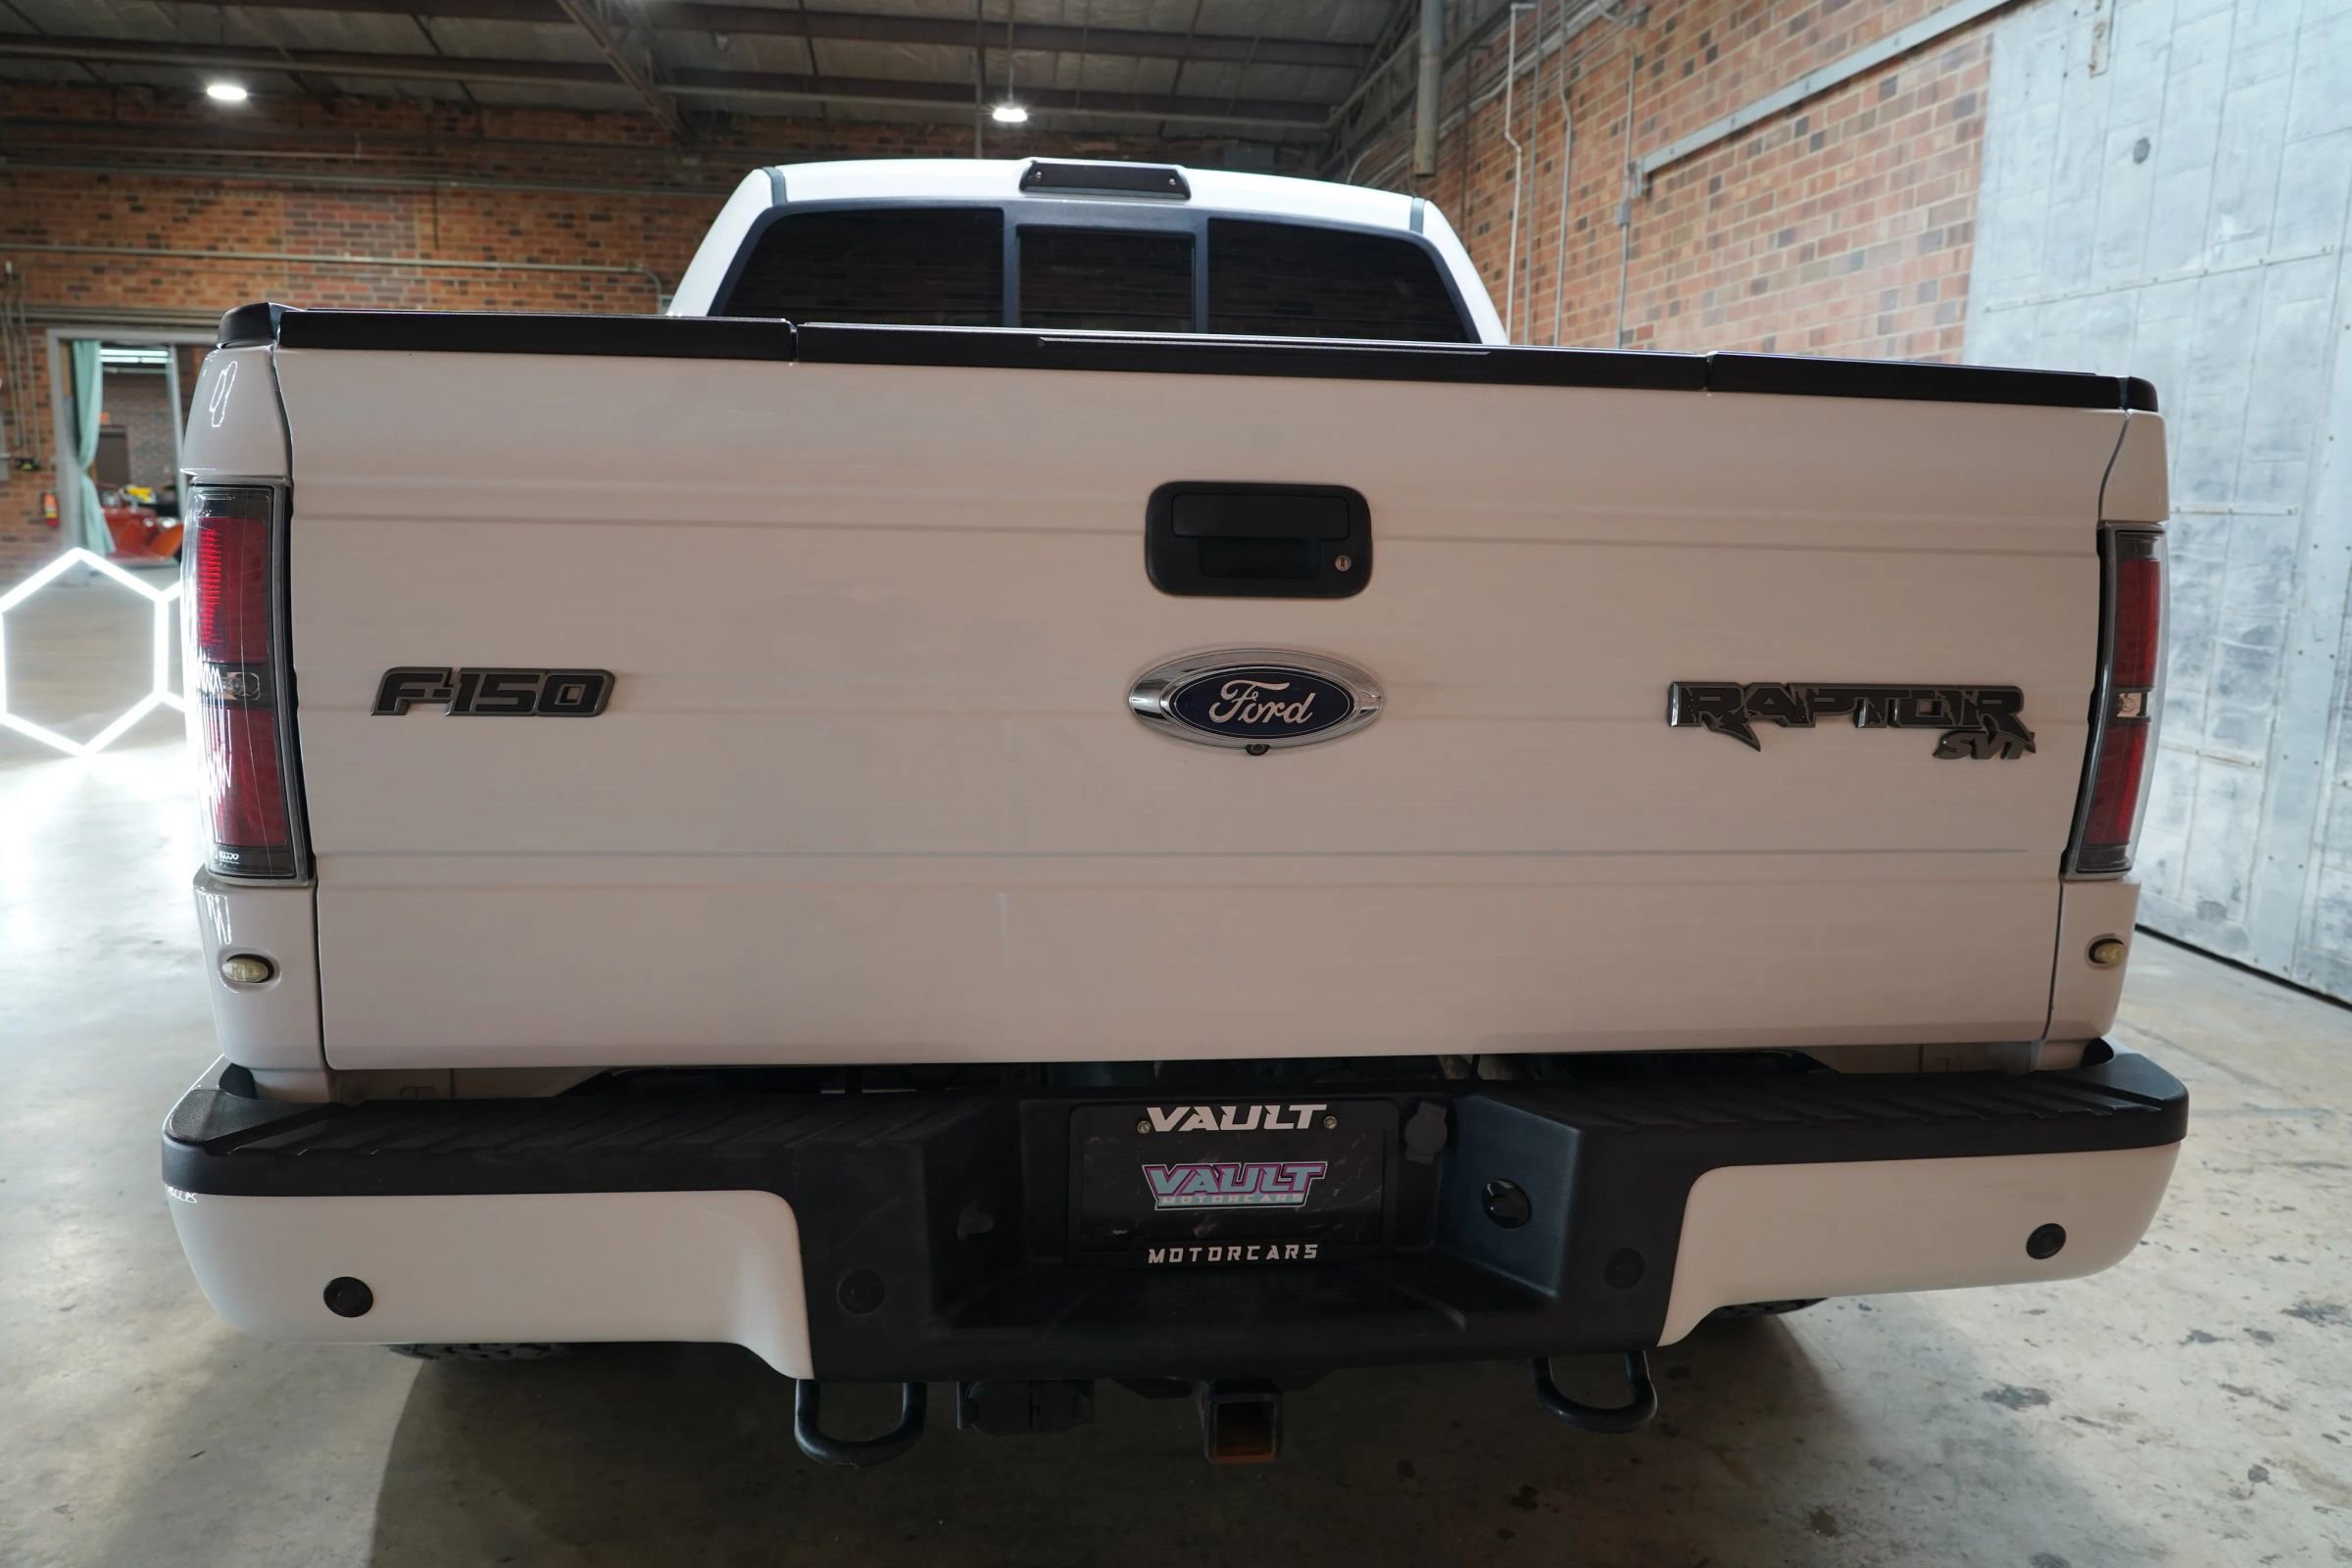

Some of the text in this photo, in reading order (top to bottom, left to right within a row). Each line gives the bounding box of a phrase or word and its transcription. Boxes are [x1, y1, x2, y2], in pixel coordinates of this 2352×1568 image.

[370, 666, 615, 717] F-150
[1208, 679, 1317, 724] Ford
[1669, 681, 2036, 754] RAPTOR
[1146, 1103, 1328, 1132] VAULT
[1145, 1163, 1326, 1197] VAULT
[1159, 1193, 1305, 1205] MOTORCARS
[1148, 1244, 1319, 1264] MOTORCARS
